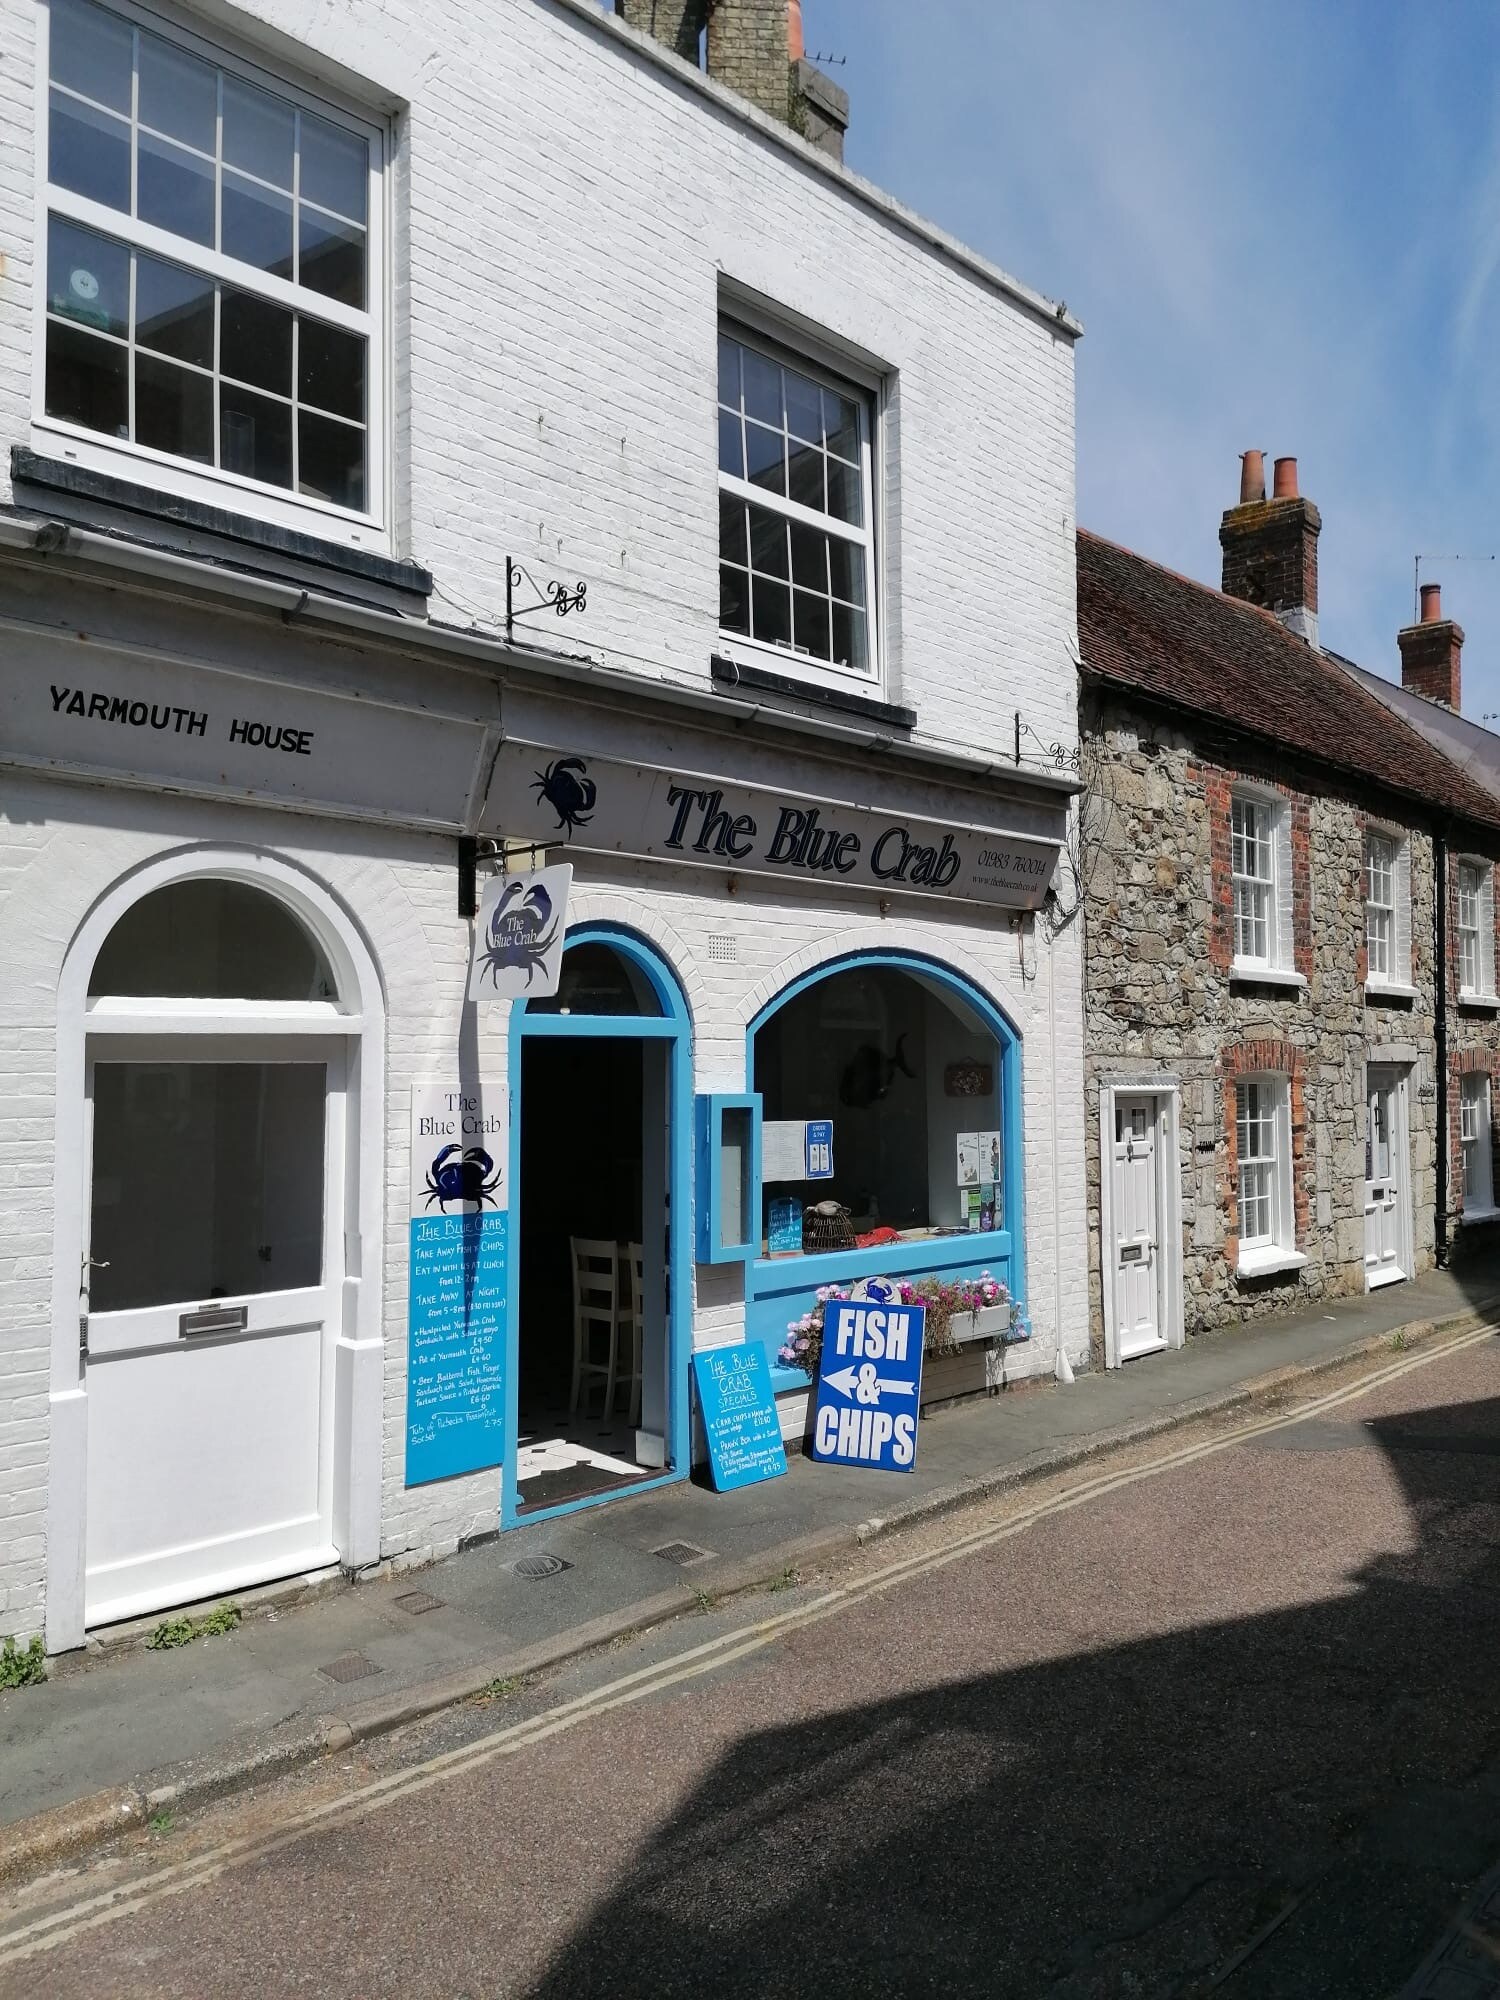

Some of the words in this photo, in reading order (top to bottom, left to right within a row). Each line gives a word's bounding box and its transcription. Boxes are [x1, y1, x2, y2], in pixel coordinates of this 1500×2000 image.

[50, 685, 208, 736] YARMOUTH
[229, 718, 314, 755] HOUSE
[664, 784, 757, 859] The
[764, 806, 861, 873] Blue
[870, 827, 961, 887] Crab
[977, 850, 1010, 869] 01983
[507, 917, 525, 932] The
[493, 933, 512, 948] Blue
[514, 929, 537, 946] Crab
[445, 1093, 477, 1111] The
[419, 1117, 455, 1136] Blue
[461, 1115, 501, 1134] Crab
[417, 1221, 440, 1238] THE
[445, 1219, 472, 1235] BLUE
[475, 1216, 502, 1231] CRAB
[415, 1247, 434, 1259] TAKE
[437, 1247, 455, 1258] AWAY
[456, 1243, 471, 1254] FISH
[481, 1241, 504, 1252] CHIPS
[416, 1266, 431, 1276] EAT
[433, 1265, 440, 1273] IN
[442, 1263, 458, 1272] WITH
[471, 1261, 480, 1269] AT
[483, 1260, 504, 1270] LUNCH
[416, 1294, 436, 1306] TAKE
[440, 1291, 459, 1302] AWAY
[466, 1290, 474, 1298] AT
[478, 1287, 500, 1297] NIGHT
[419, 1323, 451, 1337] Handpicked
[453, 1318, 480, 1330] Yarmouth
[481, 1314, 496, 1324] Crab
[836, 1308, 910, 1361] FISH
[415, 1335, 444, 1347] Sandwich
[446, 1332, 459, 1341] with
[419, 1355, 428, 1364] Pot
[430, 1353, 437, 1363] of
[438, 1349, 467, 1361] Yarmouth
[470, 1346, 484, 1355] Crab
[704, 1354, 727, 1376] THE
[733, 1353, 759, 1371] BLUE
[418, 1376, 434, 1386] Beer
[437, 1368, 464, 1383] Battered
[467, 1366, 481, 1376] Fish
[482, 1364, 500, 1375] Finger
[719, 1373, 752, 1393] CRAB
[856, 1362, 881, 1405] &
[416, 1385, 443, 1397] Sandwich
[718, 1391, 757, 1409] SPECIALS
[409, 1423, 424, 1435] Tub
[427, 1421, 434, 1431] of
[815, 1405, 915, 1465] CHIPS
